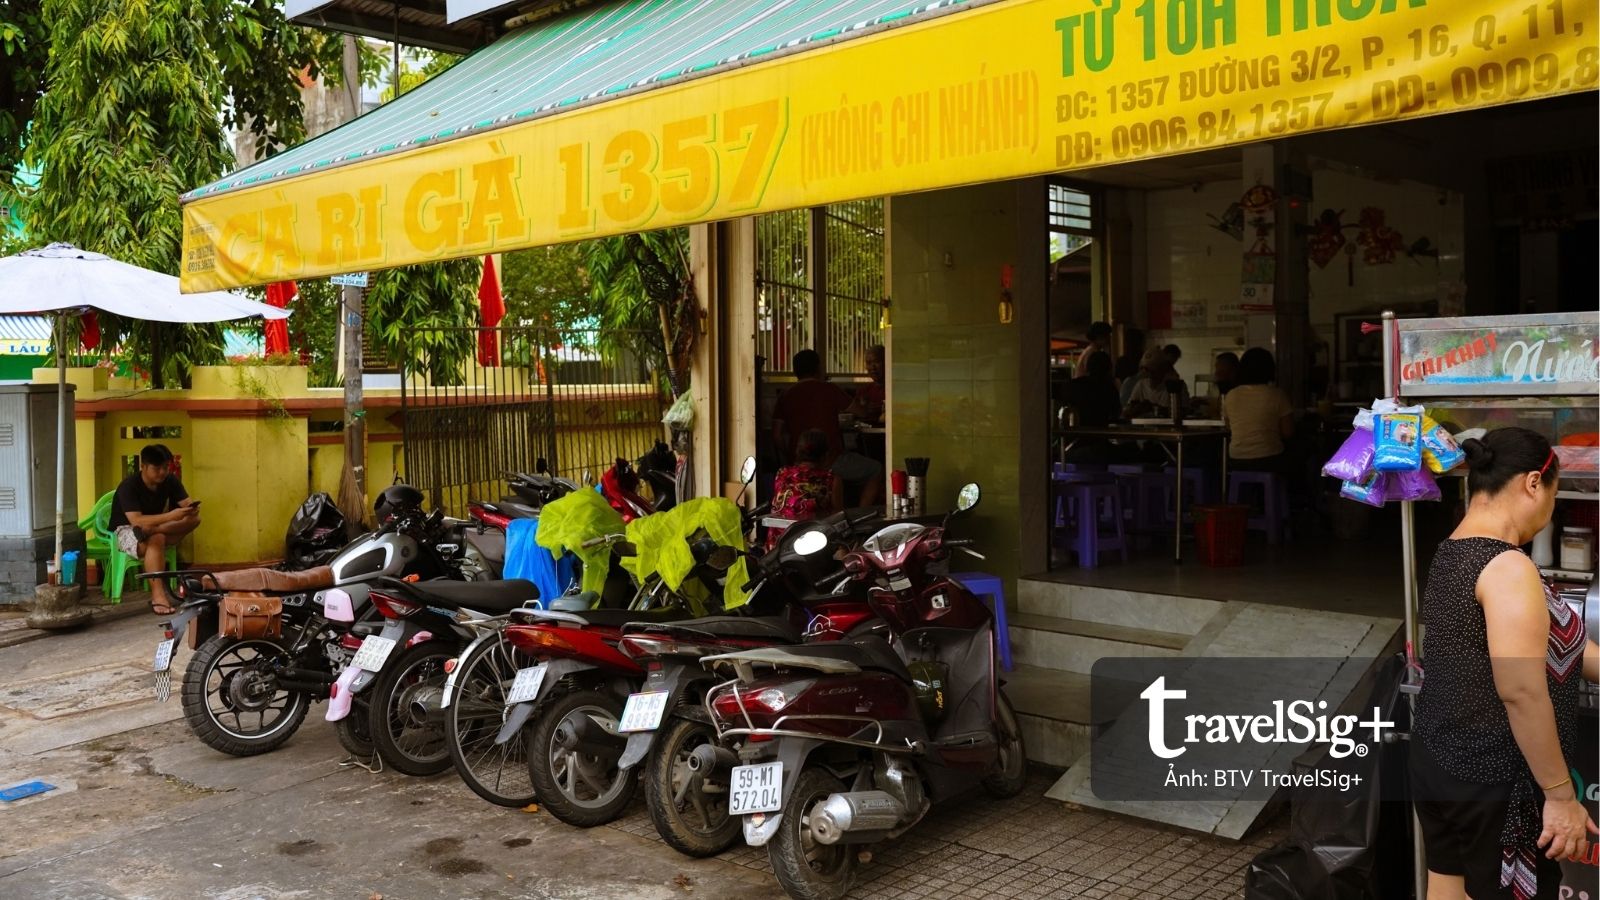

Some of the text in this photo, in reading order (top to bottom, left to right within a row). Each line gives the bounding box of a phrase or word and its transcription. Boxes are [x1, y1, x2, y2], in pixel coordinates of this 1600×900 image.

[1056, 0, 1584, 123] ĐC: 1357 ĐƯỜNG 3/2, P. 16, Q. 11,
[1135, 0, 1235, 62] 10H
[801, 62, 1039, 190] (KHÔNG CHI NHÁNH)
[1056, 130, 1102, 168] DĐ:
[1111, 91, 1334, 158] 0906.84.1357
[1371, 74, 1437, 118] DĐ:
[220, 97, 786, 280] CÀ RI GÀ 1357
[733, 788, 778, 811] 572.04
[739, 766, 773, 789] 59-M1
